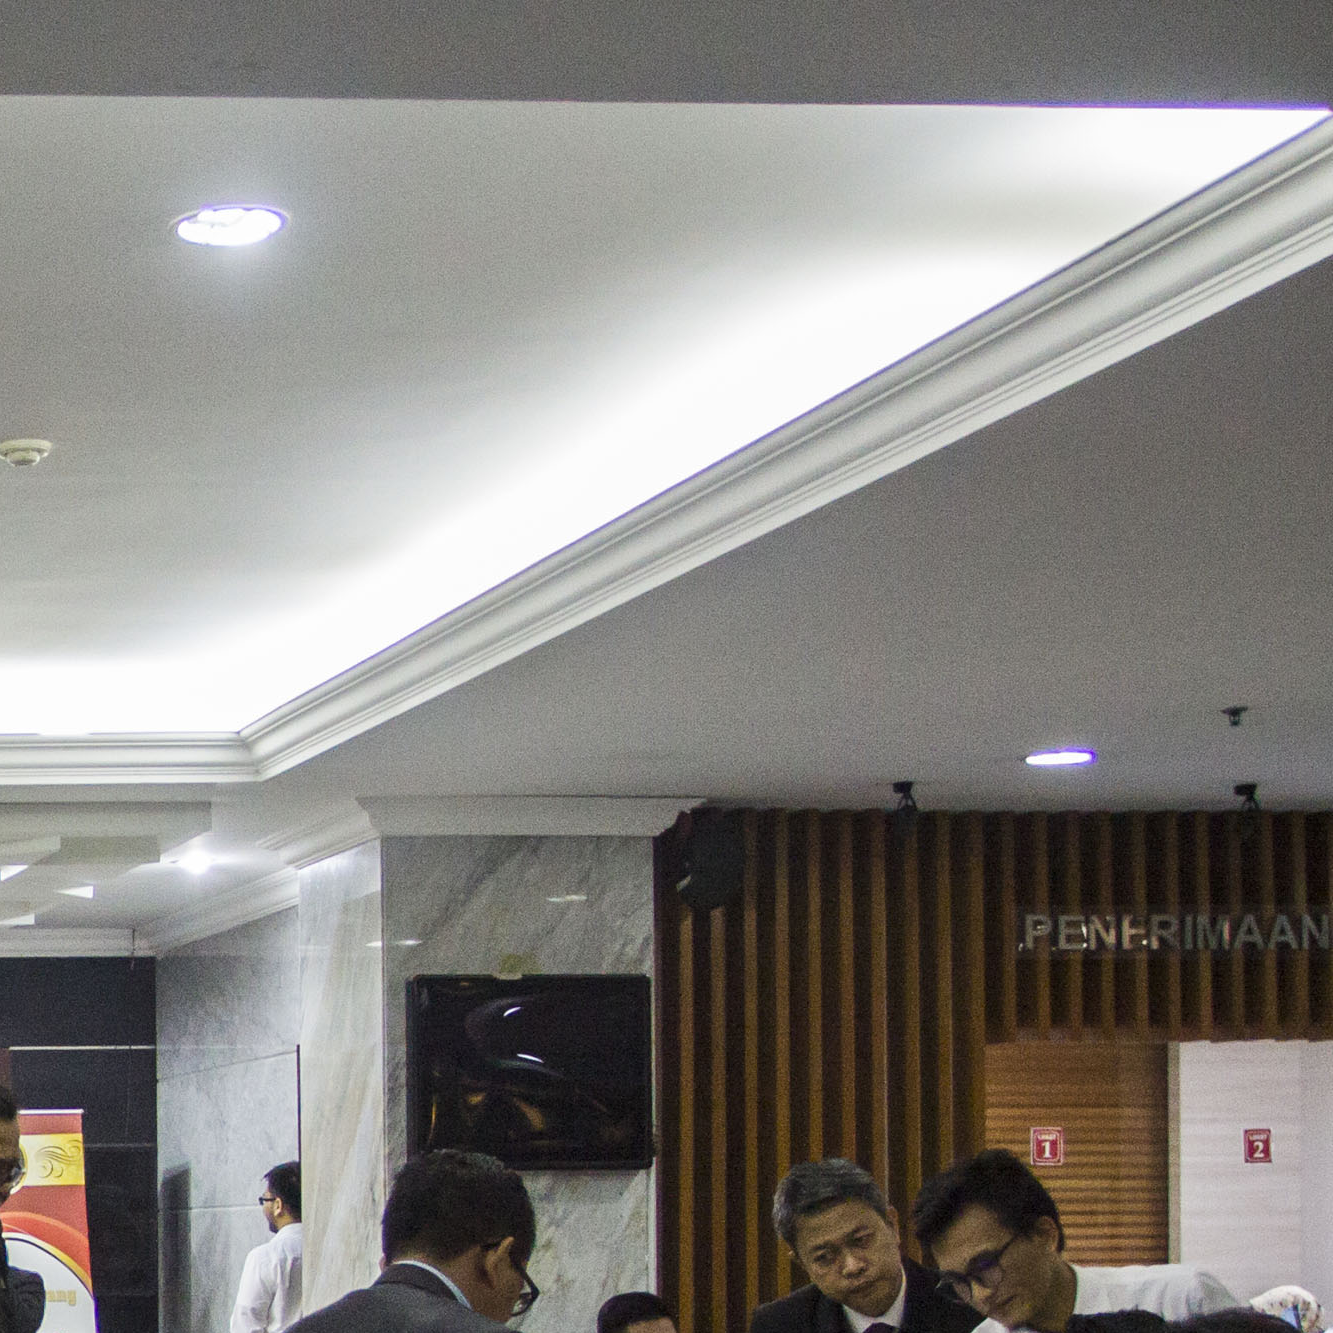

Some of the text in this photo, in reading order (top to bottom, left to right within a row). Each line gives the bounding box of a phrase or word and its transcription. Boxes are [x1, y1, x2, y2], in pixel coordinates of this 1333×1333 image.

[1025, 914, 1329, 950] PENERIMAAN
[1042, 1141, 1052, 1158] 1
[1253, 1141, 1264, 1158] 2
